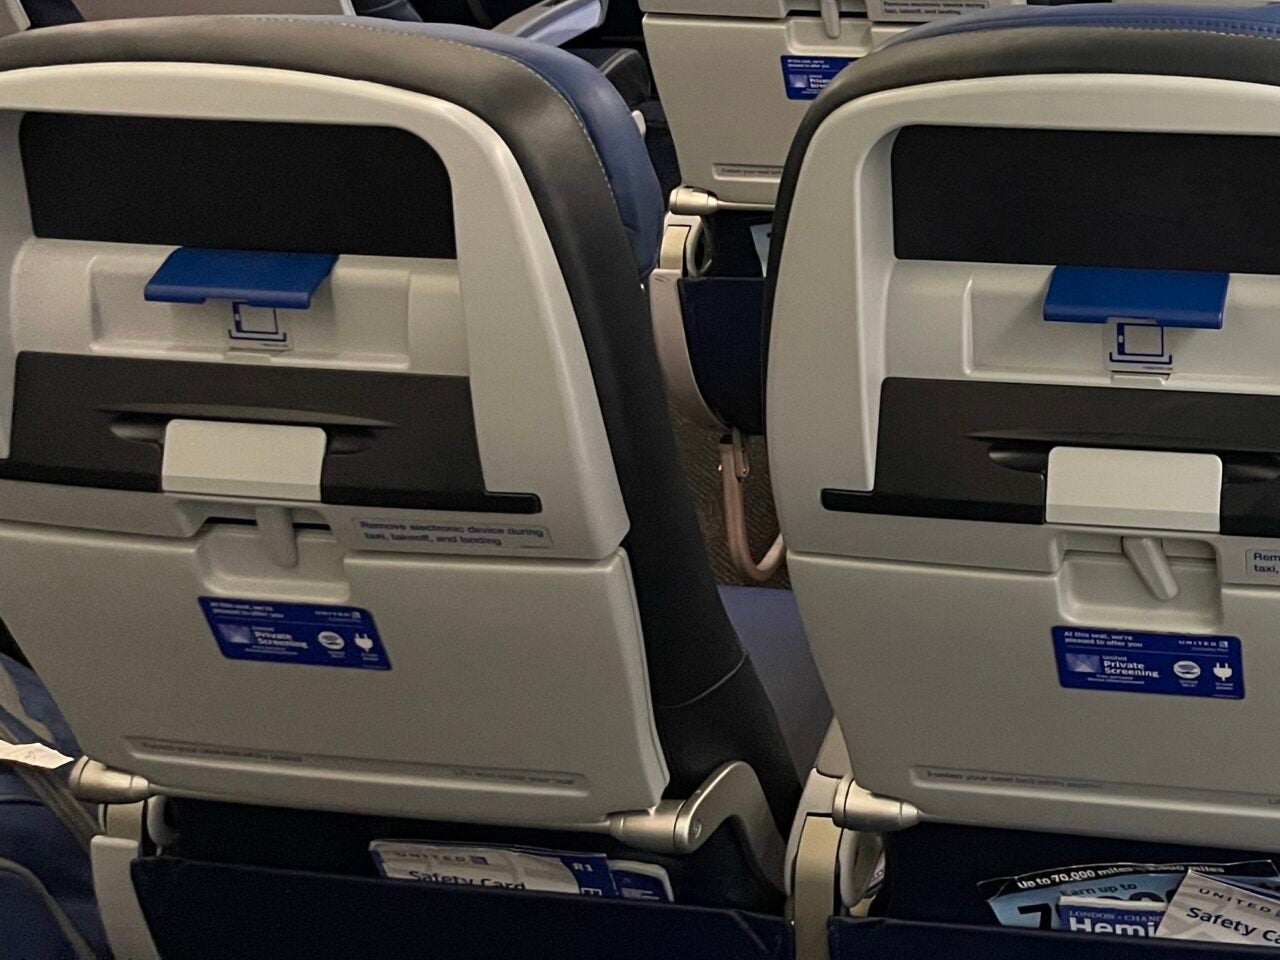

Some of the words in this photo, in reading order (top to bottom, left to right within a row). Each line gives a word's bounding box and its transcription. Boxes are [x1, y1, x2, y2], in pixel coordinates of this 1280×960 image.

[360, 521, 407, 530] Remove
[410, 523, 464, 533] electronic
[467, 525, 505, 535] device
[507, 527, 544, 538] during
[436, 535, 457, 543] and
[460, 535, 502, 546] landing
[1254, 565, 1279, 575] taxi,
[1103, 660, 1145, 670] Private
[1104, 667, 1160, 678] Screening
[1035, 877, 1051, 885] to
[1097, 866, 1134, 877] miles
[1097, 885, 1118, 893] up
[1198, 888, 1272, 913] UNITED
[1069, 910, 1115, 920] LONDON
[1186, 906, 1258, 936] Safety
[1069, 917, 1156, 937] Hemi
